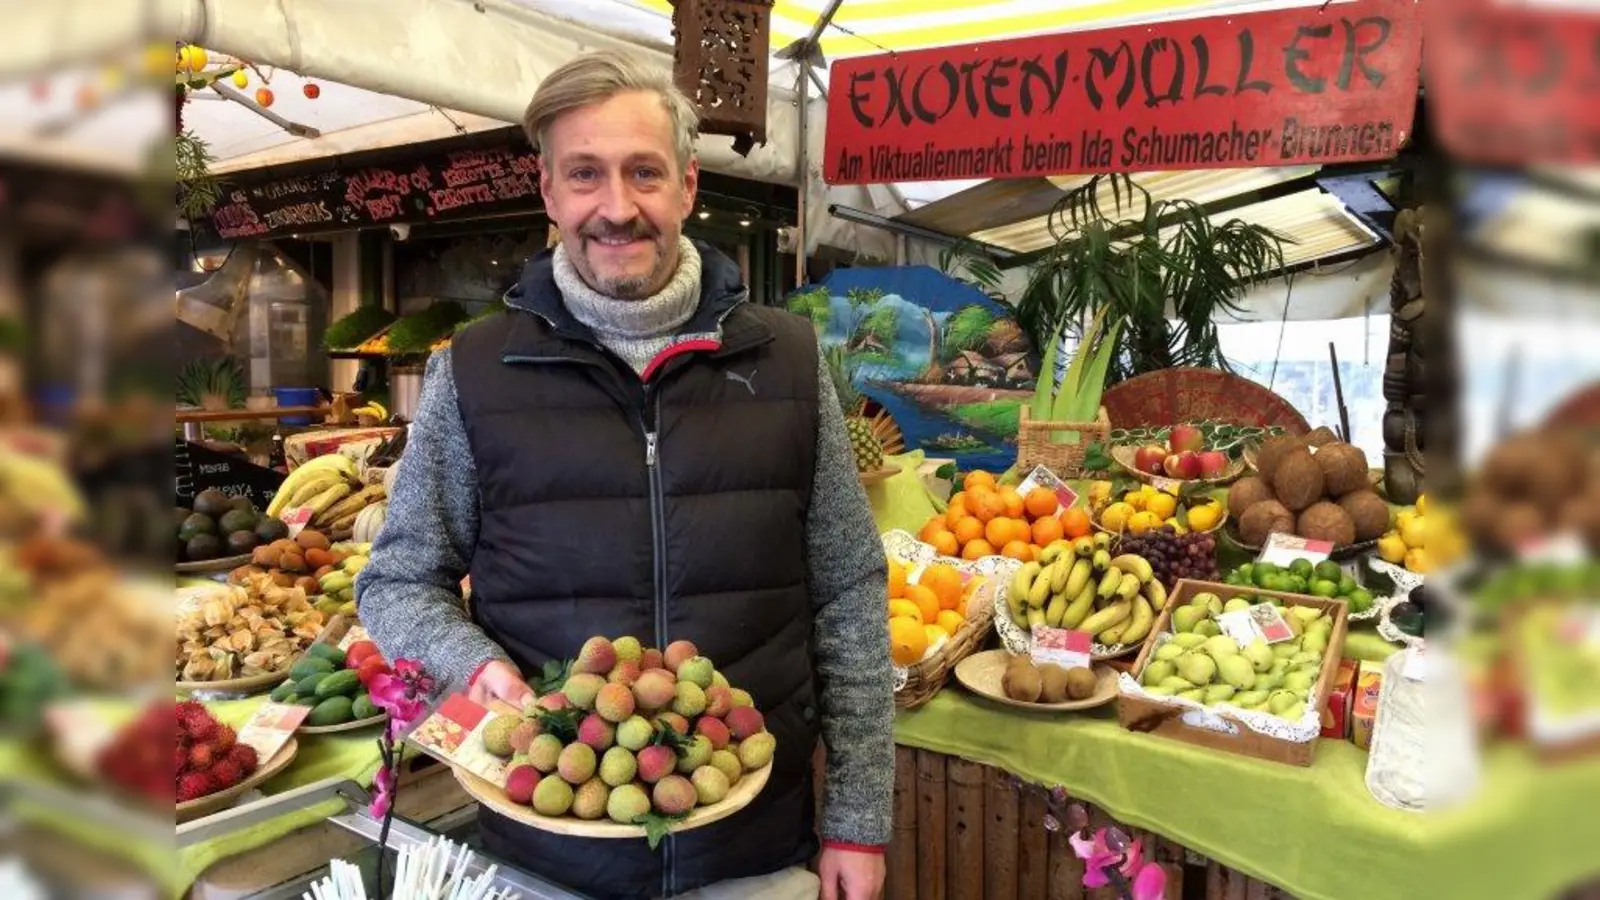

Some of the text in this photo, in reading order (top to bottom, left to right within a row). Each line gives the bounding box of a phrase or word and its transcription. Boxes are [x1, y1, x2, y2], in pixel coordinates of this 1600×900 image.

[836, 147, 863, 181] Am
[869, 137, 1015, 180] Viktualienmarkt
[1021, 134, 1073, 172] beim
[1080, 129, 1113, 170] Ida
